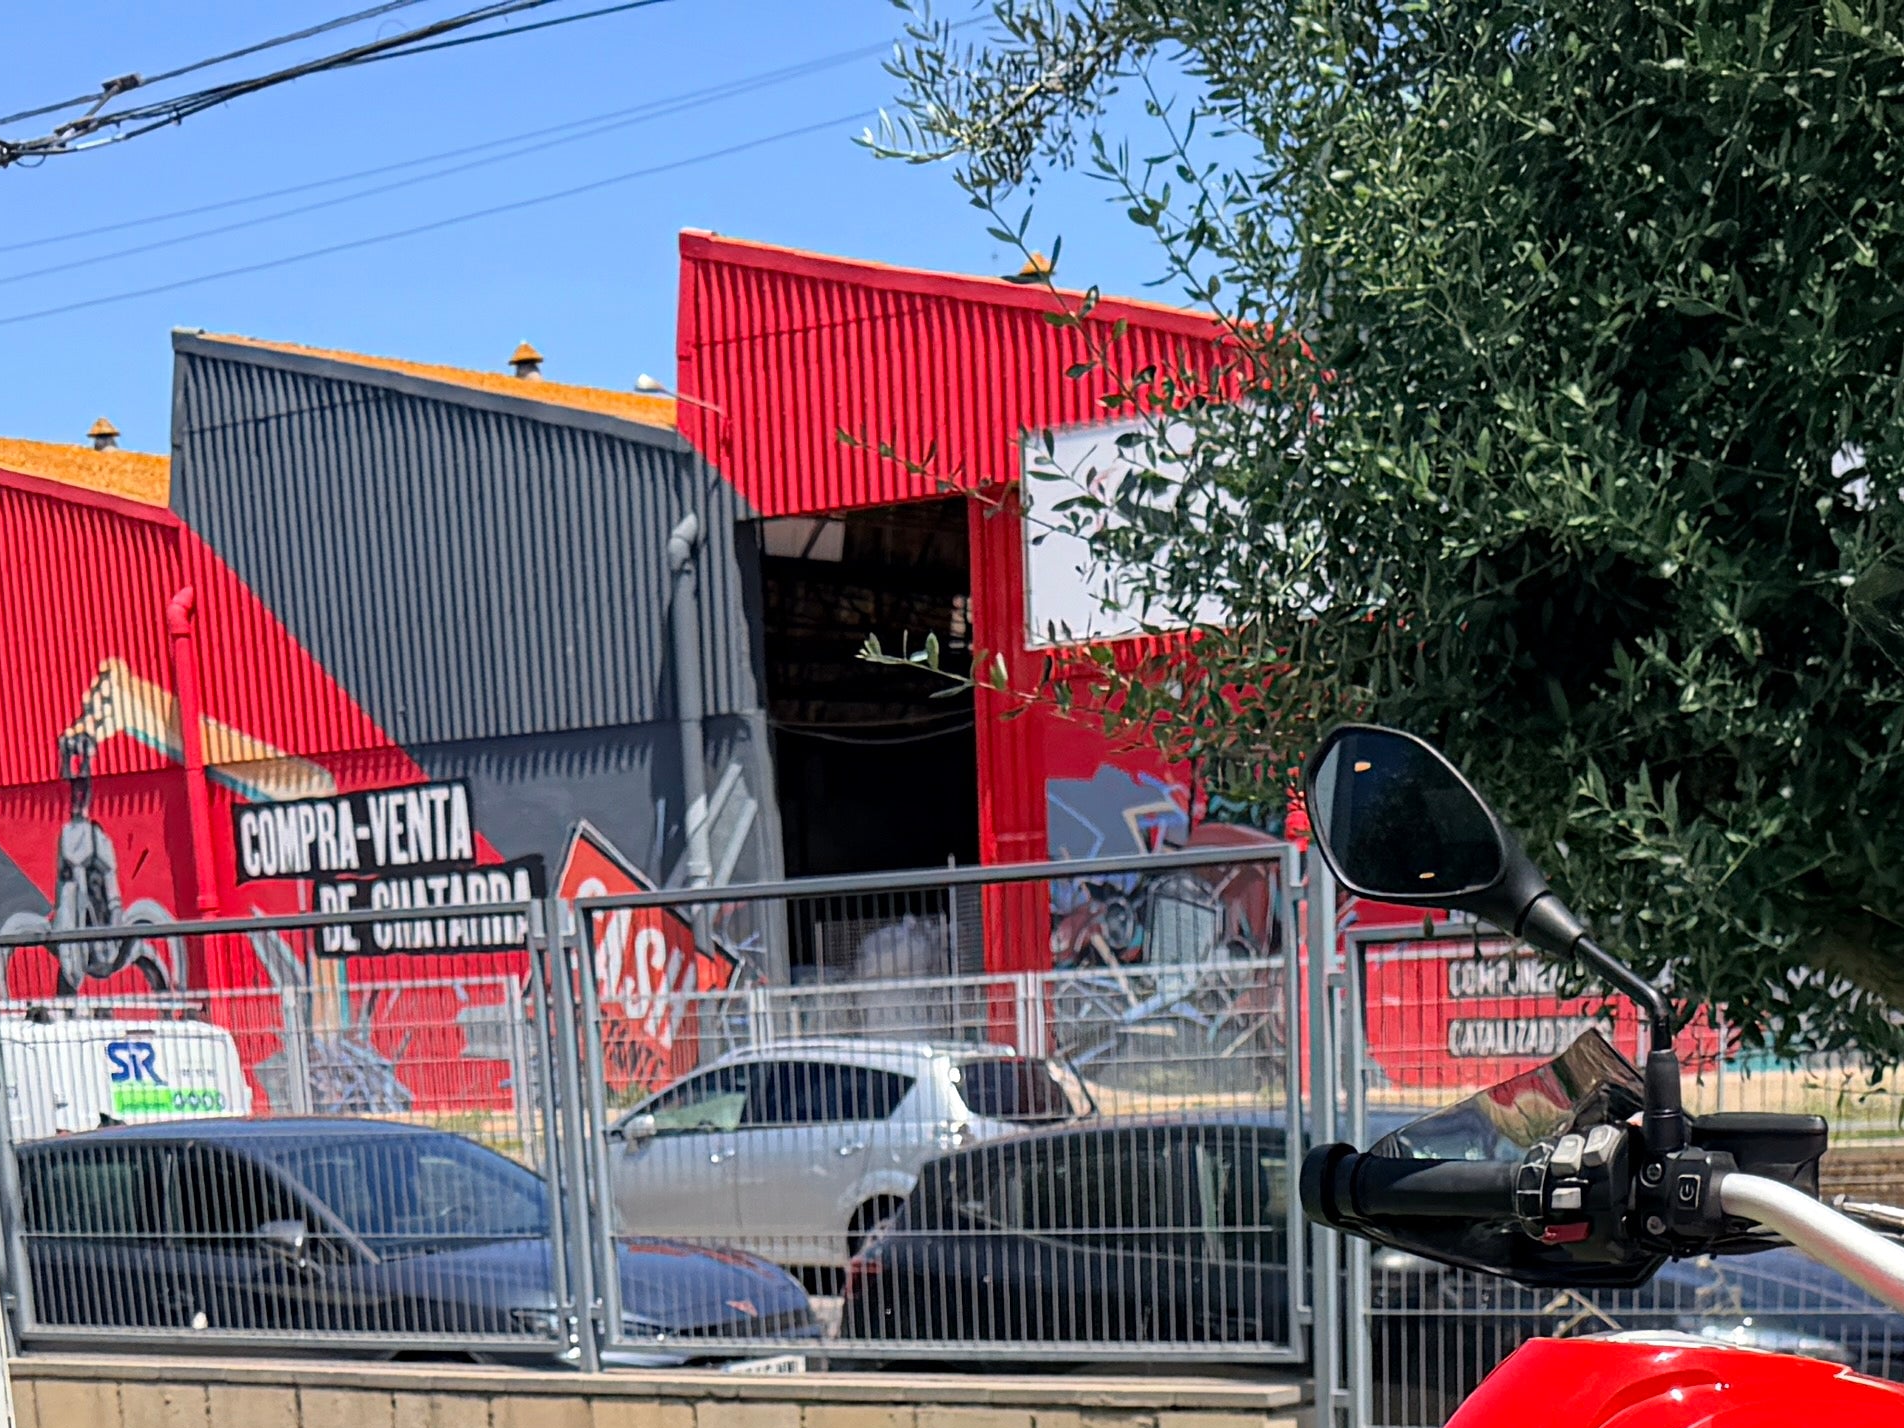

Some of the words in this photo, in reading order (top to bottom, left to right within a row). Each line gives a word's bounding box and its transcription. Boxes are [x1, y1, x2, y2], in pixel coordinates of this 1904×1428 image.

[240, 783, 474, 877] COMPRA-VENTA
[319, 883, 361, 951] DE
[371, 867, 533, 950] CHATARRA
